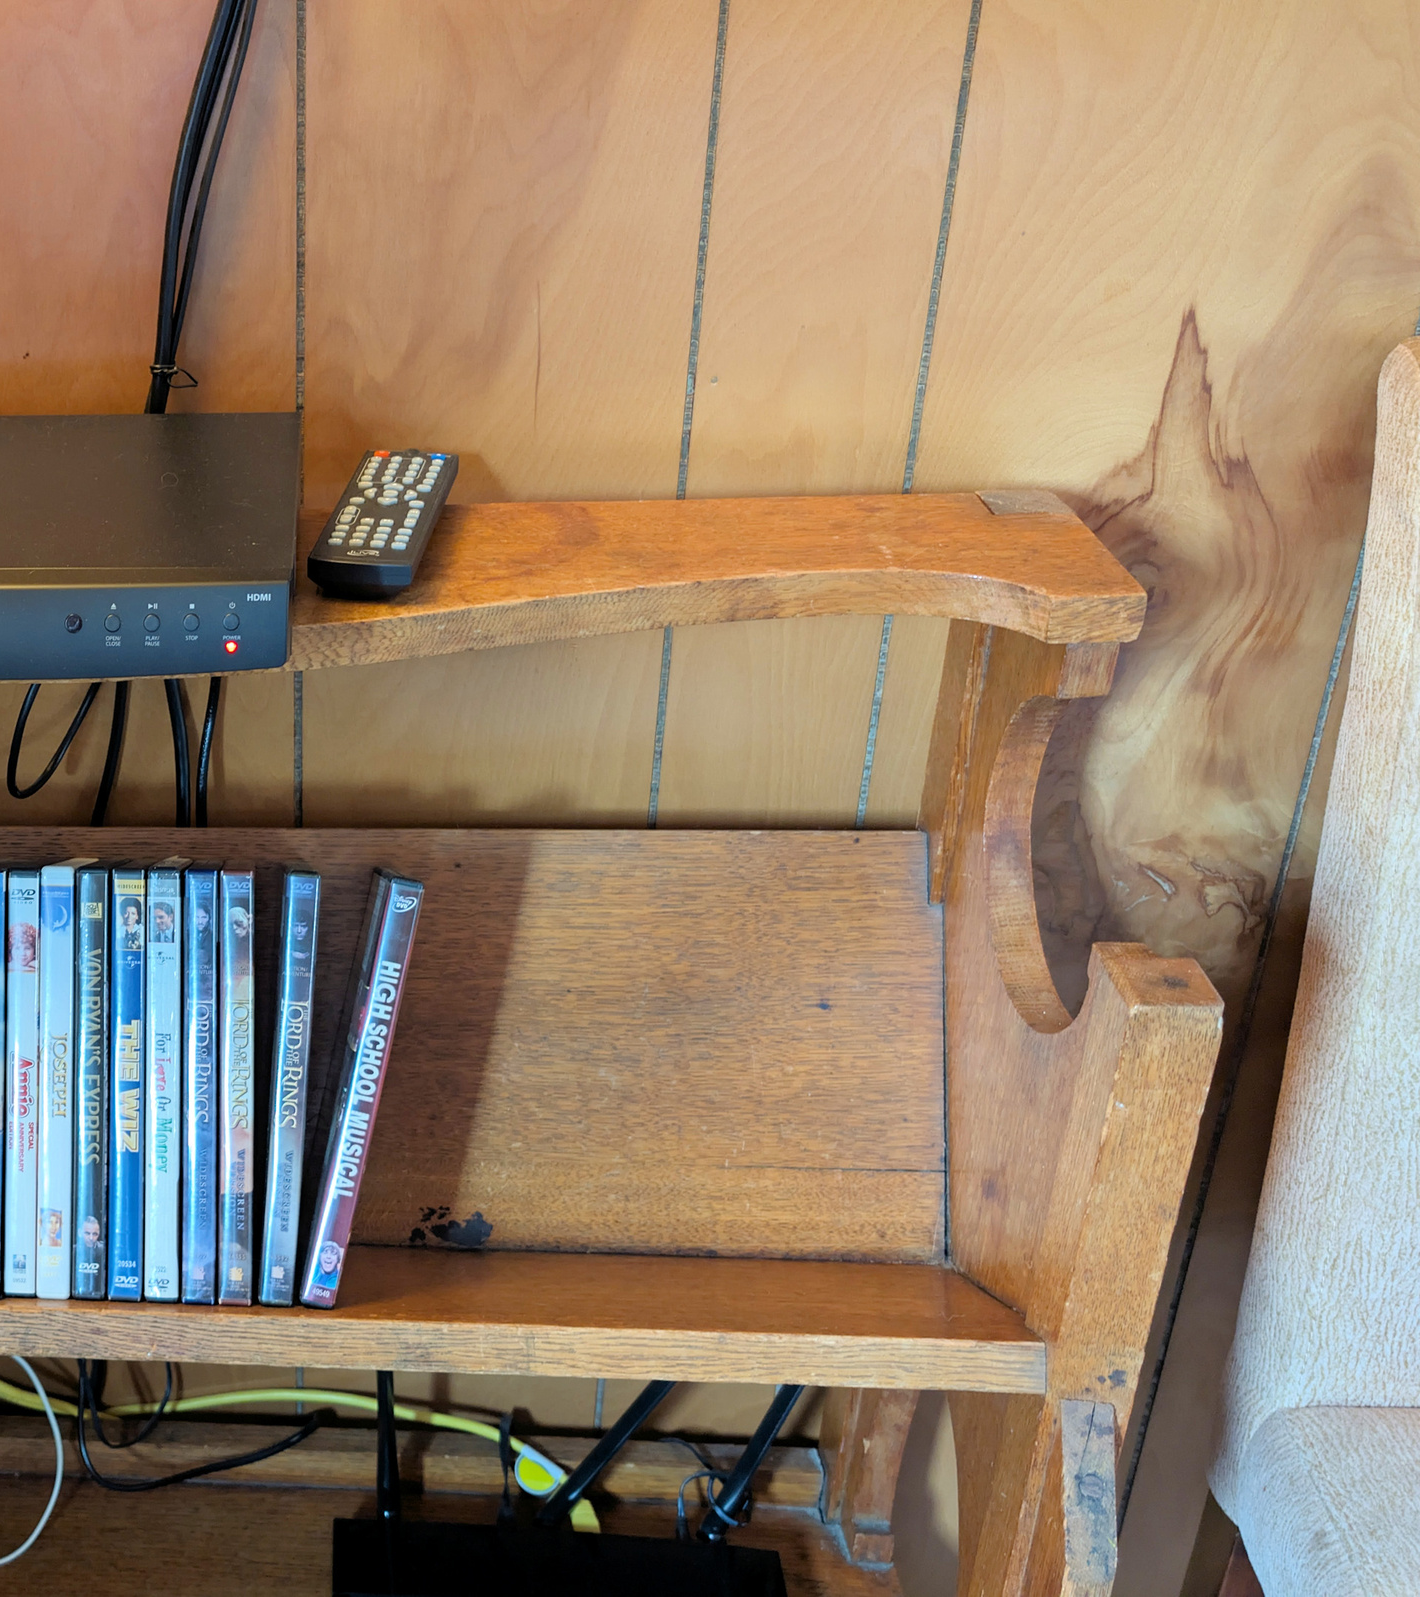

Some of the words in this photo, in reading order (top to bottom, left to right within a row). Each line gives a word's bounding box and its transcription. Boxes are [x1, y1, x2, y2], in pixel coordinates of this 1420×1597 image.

[246, 593, 272, 601] HDMI
[82, 948, 102, 991] VON
[371, 960, 401, 1021] HIGH
[83, 996, 101, 1066] RYAN'S
[119, 1019, 140, 1082] THE
[156, 1033, 171, 1053] For
[188, 998, 212, 1047] LORD
[232, 998, 252, 1048] LORD
[281, 998, 308, 1050] LORD
[51, 1032, 68, 1118] JOSEPH
[201, 1049, 208, 1060] OF
[240, 1052, 247, 1064] OF
[285, 1049, 293, 1066] THE
[292, 1052, 300, 1064] OF
[353, 1022, 388, 1106] SCHOOL
[11, 1056, 34, 1117] Annie
[156, 1096, 171, 1112] Or
[195, 1063, 211, 1124] RINGS
[231, 1066, 251, 1130] RINGS
[280, 1065, 303, 1129] RINGS
[83, 1074, 100, 1166] EXPRESS
[118, 1088, 140, 1153] WIZ
[150, 1118, 172, 1173] Money
[333, 1110, 370, 1200] MUSICAL
[198, 1148, 208, 1230] WIDESCREEN
[236, 1148, 246, 1231] WIDESCREEN
[280, 1150, 294, 1233] WIDESCREEN
[115, 1276, 139, 1284] DVD
